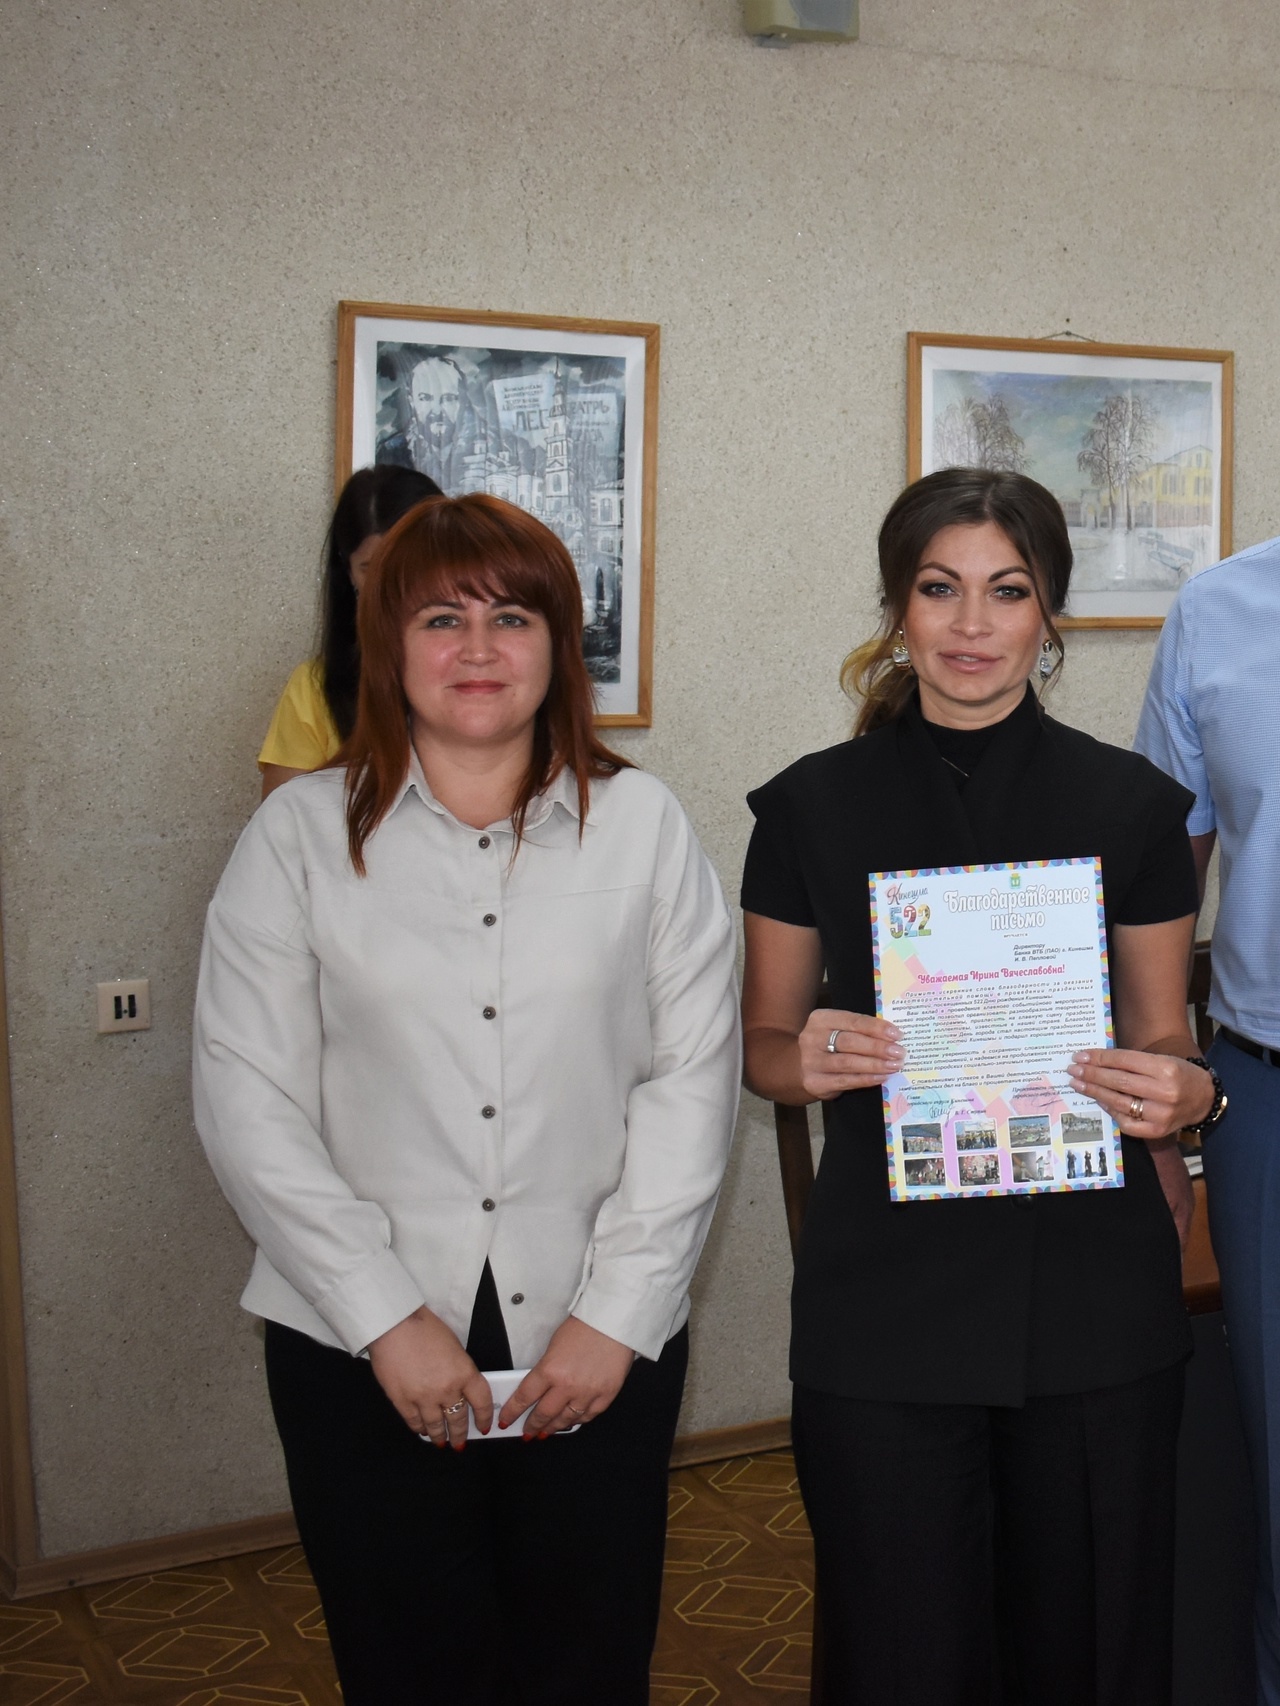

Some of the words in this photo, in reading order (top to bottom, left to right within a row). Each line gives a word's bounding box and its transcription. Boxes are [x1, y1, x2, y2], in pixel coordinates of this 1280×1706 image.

[886, 882, 929, 906] Кинешма
[943, 885, 1089, 914] Благодарственное
[889, 903, 933, 939] 522
[990, 910, 1046, 931] письмо
[1013, 942, 1046, 951] Директору
[917, 972, 968, 984] Уважаемая
[970, 969, 999, 982] Ирина
[1000, 965, 1065, 978] Вячеславовна!
